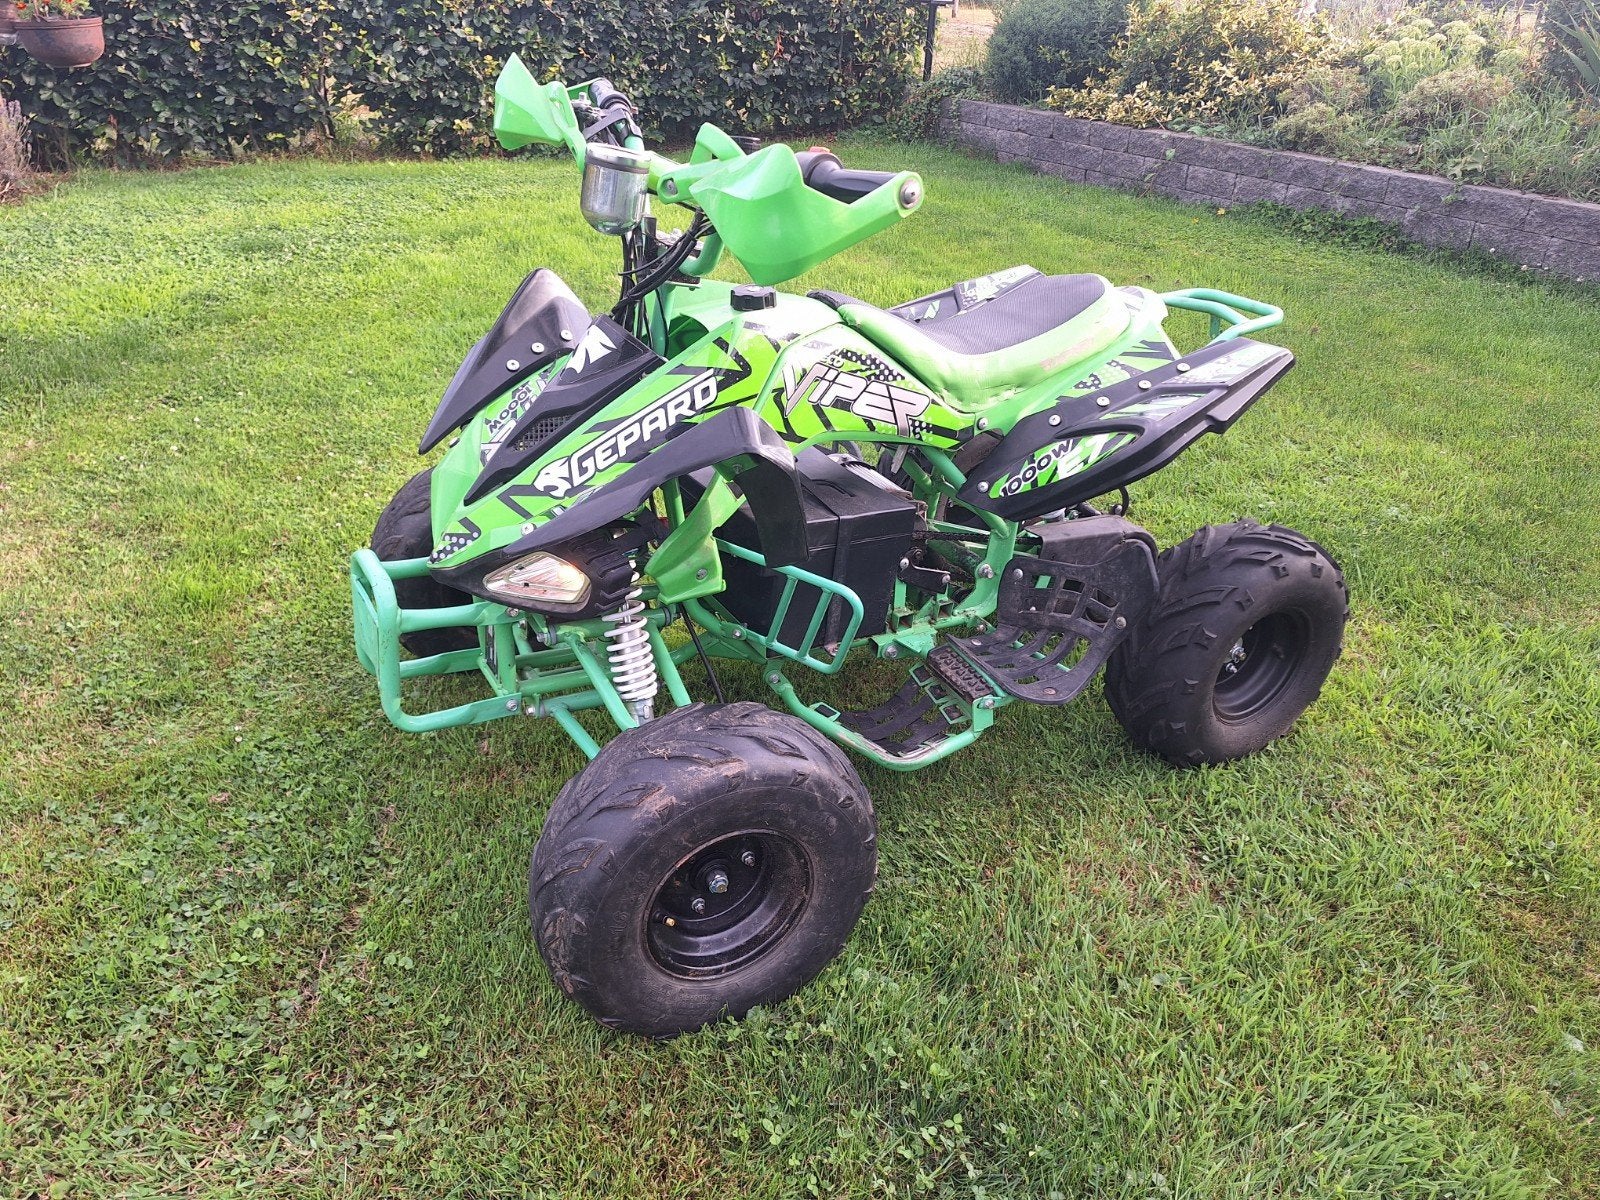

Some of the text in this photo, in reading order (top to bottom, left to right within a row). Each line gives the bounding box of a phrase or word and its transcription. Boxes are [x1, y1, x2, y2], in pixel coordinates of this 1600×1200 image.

[488, 384, 534, 435] 1000W
[570, 368, 719, 487] GEPARD
[1000, 439, 1073, 497] 1000W
